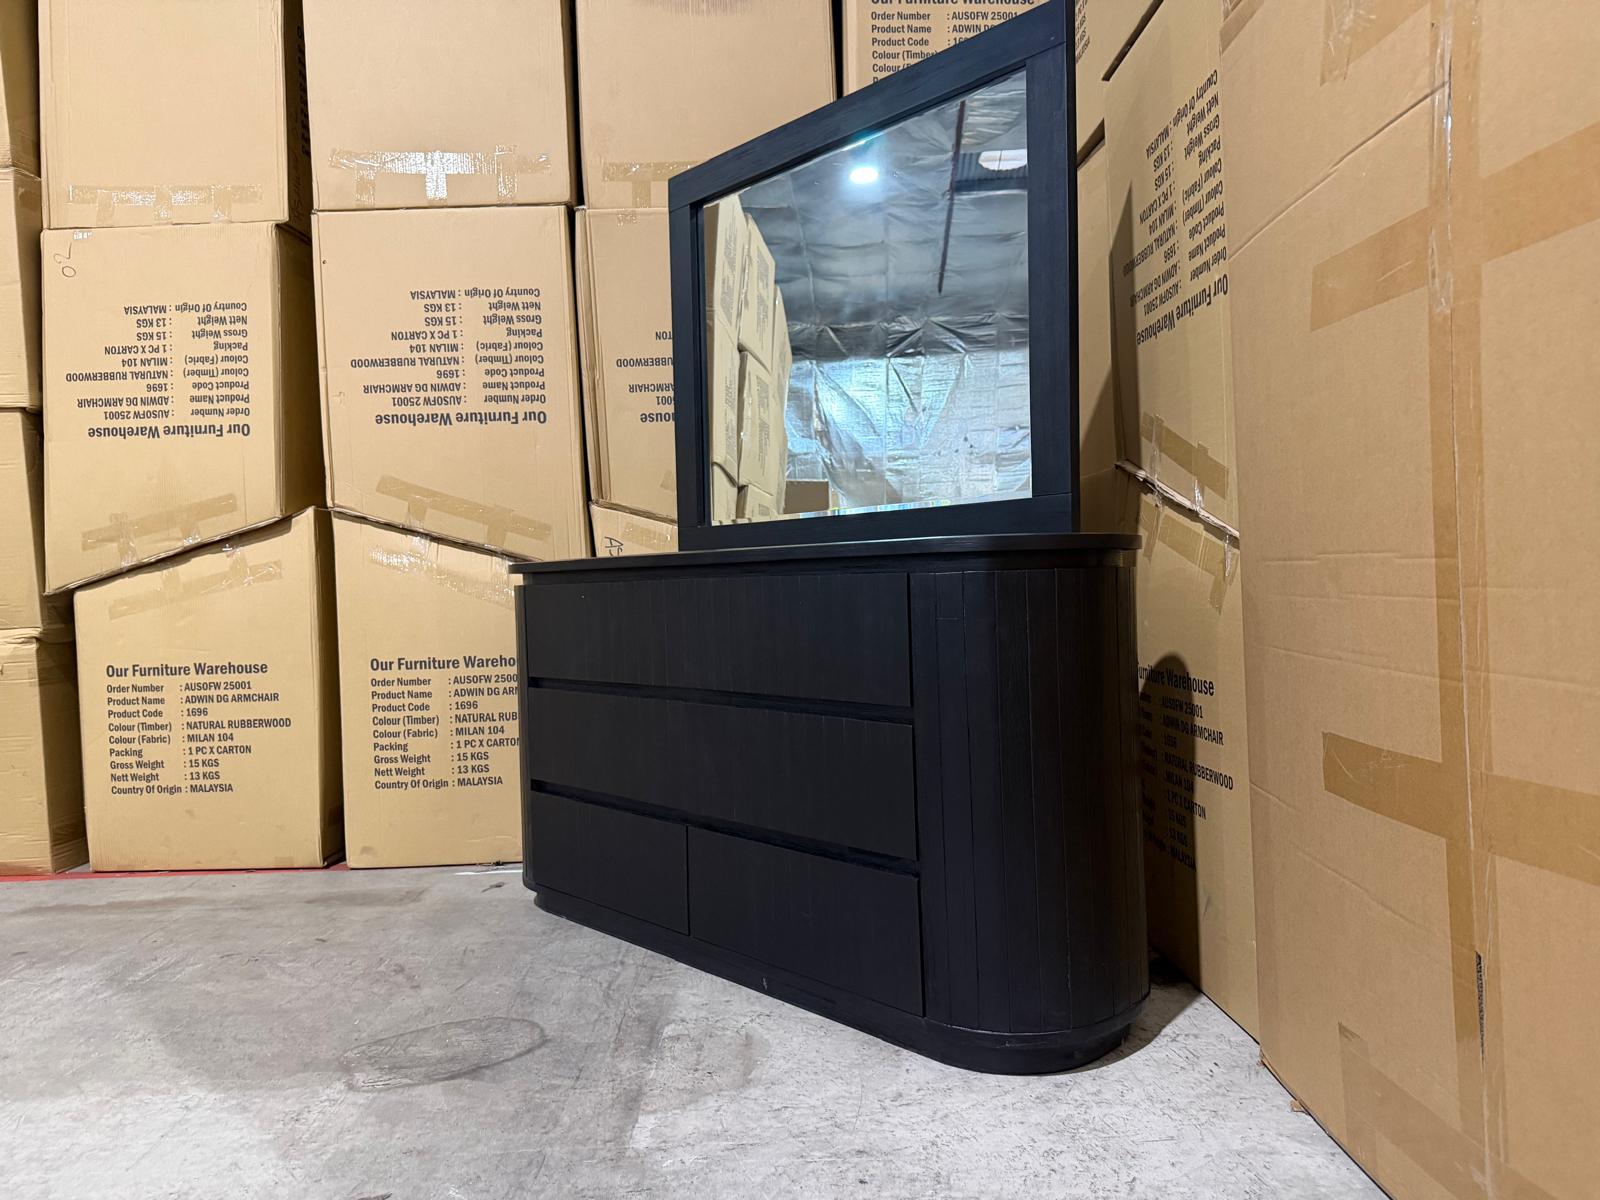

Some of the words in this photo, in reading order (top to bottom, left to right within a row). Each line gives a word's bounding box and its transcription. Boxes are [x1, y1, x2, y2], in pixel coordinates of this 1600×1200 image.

[871, 12, 895, 20] Order
[897, 12, 930, 20] Number
[952, 12, 989, 20] AUSOFW
[872, 38, 906, 46] Product
[907, 38, 929, 46] Code
[872, 51, 899, 60] Colour
[1196, 69, 1217, 102] Country
[1188, 96, 1195, 113] Of
[1173, 104, 1188, 127] Origin
[1146, 124, 1169, 159] MALAYSIA
[1204, 158, 1222, 184] Colour
[1182, 173, 1203, 205] (Fabric)
[1158, 203, 1174, 226] MILAN
[1149, 217, 1158, 236] 104
[1212, 246, 1226, 266] Order
[1190, 258, 1210, 281] Number
[1214, 274, 1228, 297] Our
[1160, 282, 1178, 306] AUSOFW
[175, 302, 200, 313] Origin
[214, 301, 247, 312] Country
[445, 303, 456, 312] 13
[488, 300, 520, 311] Weight
[521, 302, 541, 310] Nett
[1144, 296, 1158, 316] 25001
[1176, 285, 1211, 320] Furniture
[124, 305, 166, 315] MALAYSIA
[202, 304, 212, 313] Of
[424, 304, 442, 313] KGS
[136, 318, 154, 328] KGS
[156, 318, 166, 328] 13
[197, 314, 227, 326] Weight
[229, 316, 247, 325] Nett
[424, 316, 443, 326] KGS
[445, 316, 456, 326] 15
[483, 313, 514, 325] Weight
[516, 314, 542, 324] Gross
[1136, 310, 1175, 344] Warehouse
[136, 332, 154, 341] KGS
[156, 331, 166, 340] 15
[192, 328, 222, 339] Weight
[223, 329, 248, 338] Gross
[409, 344, 426, 353] 104
[430, 343, 458, 353] MILAN
[476, 340, 512, 352] (Fabric)
[514, 342, 543, 351] Colour
[350, 357, 416, 368] RUBBERWOOD
[418, 356, 460, 366] NATURAL
[475, 353, 512, 365] (Timber)
[514, 355, 544, 364] Colour
[616, 357, 673, 367] UBBERWOOD
[66, 371, 127, 382] RUBBERWOOD
[129, 370, 168, 380] NATURAL
[183, 367, 219, 378] (Timber)
[221, 368, 249, 377] Colour
[436, 369, 460, 379] 1696
[484, 368, 508, 378] Code
[509, 368, 544, 377] Product
[146, 383, 168, 392] 1696
[192, 382, 214, 391] Code
[215, 381, 249, 390] Product
[363, 384, 413, 394] ARMCHAIR
[415, 384, 428, 392] DG
[430, 382, 461, 392] ADWIN
[482, 382, 508, 390] Name
[510, 381, 545, 390] Product
[77, 397, 124, 408] ARMCHAIR
[126, 397, 138, 407] DG
[140, 396, 169, 406] ADWIN
[190, 395, 214, 404] Name
[216, 394, 250, 404] Product
[392, 396, 421, 407] 25001
[423, 396, 462, 406] AUSOFW
[484, 394, 519, 404] Number
[521, 394, 546, 404] Order
[104, 410, 131, 420] 25001
[132, 410, 170, 419] AUSOFW
[190, 408, 224, 418] Number
[226, 408, 250, 416] Order
[522, 411, 546, 424] Our
[375, 413, 452, 426] Warehouse
[456, 412, 518, 425] Furniture
[88, 426, 160, 439] Warehouse
[163, 424, 223, 438] Furniture
[227, 424, 250, 436] Our
[370, 658, 394, 671] Our
[398, 657, 460, 670] Furniture
[463, 655, 516, 668] Wareho
[106, 665, 129, 678] Our
[132, 664, 190, 677] Furniture
[193, 662, 268, 675] Warehouse
[1138, 664, 1165, 685] urniture
[371, 678, 395, 687] Order
[397, 677, 431, 686] Number
[453, 674, 492, 684] AUSOFW
[494, 674, 518, 683] 2500
[107, 684, 130, 693] Order
[132, 684, 164, 692] Number
[184, 682, 222, 692] AUSOFW
[223, 681, 252, 690] 25001
[372, 690, 405, 700] Product
[407, 690, 432, 699] Name
[454, 688, 484, 698] ADWIN
[487, 687, 500, 696] DG
[107, 697, 140, 706] Product
[142, 696, 165, 705] Name
[185, 694, 214, 704] ADWIN
[216, 694, 229, 703] DG
[231, 693, 279, 703] ARMCHAIR
[372, 703, 406, 712] Product
[408, 702, 430, 711] Code
[455, 700, 478, 710] 1696
[108, 709, 140, 718] Product
[142, 709, 163, 718] Code
[186, 707, 208, 717] 1696
[372, 716, 401, 726] Colour
[403, 715, 439, 727] (Timber)
[455, 712, 496, 723] NATURAL
[108, 723, 136, 732] Colour
[137, 722, 172, 733] (Timber)
[186, 720, 226, 730] NATURAL
[228, 718, 291, 729] RUBBERWOOD
[373, 730, 401, 738] Colour
[403, 728, 438, 740] (Fabric)
[456, 726, 484, 736] MILAN
[488, 726, 505, 735] 104
[109, 736, 136, 744] Colour
[138, 734, 170, 745] (Fabric)
[187, 733, 215, 742] MILAN
[218, 733, 234, 742] 104
[110, 761, 134, 769] Gross
[135, 760, 164, 770] Weight
[189, 759, 200, 768] 15
[202, 758, 219, 768] KGS
[374, 768, 393, 776] Nett
[394, 767, 425, 778] Weight
[457, 765, 468, 774] 13
[471, 764, 489, 774] KGS
[375, 780, 408, 790] Country
[410, 779, 420, 788] Of
[422, 779, 448, 789] Origin
[458, 776, 503, 786] MALAYSIA
[112, 786, 144, 796] Country
[146, 784, 155, 794] Of
[157, 785, 182, 795] Origin
[190, 784, 233, 792] MALAYSIA
